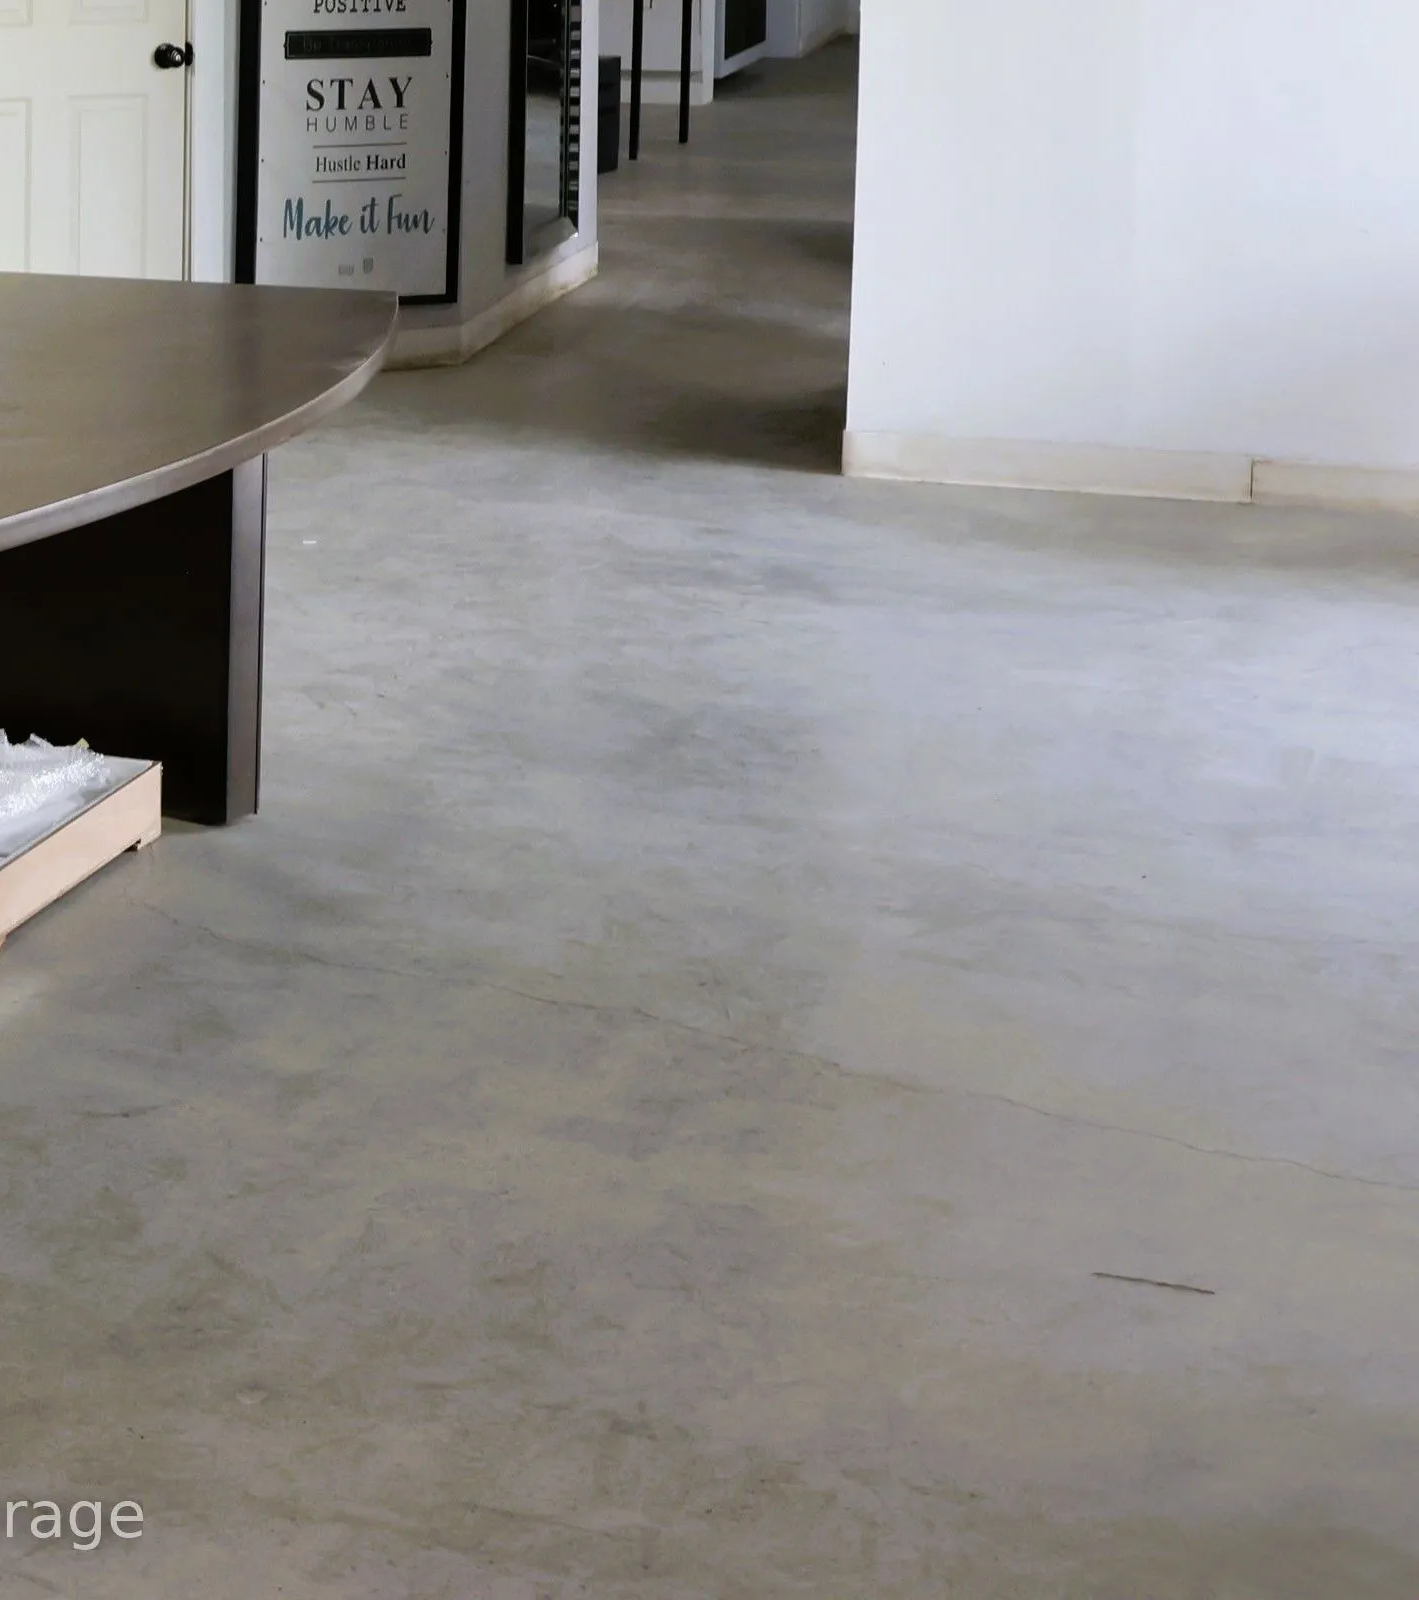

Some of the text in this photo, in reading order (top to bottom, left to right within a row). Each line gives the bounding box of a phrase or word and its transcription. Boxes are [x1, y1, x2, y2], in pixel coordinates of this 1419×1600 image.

[306, 76, 413, 111] STAY
[306, 113, 409, 133] HUMBLE
[365, 154, 407, 172] Hard
[283, 197, 353, 241] Make
